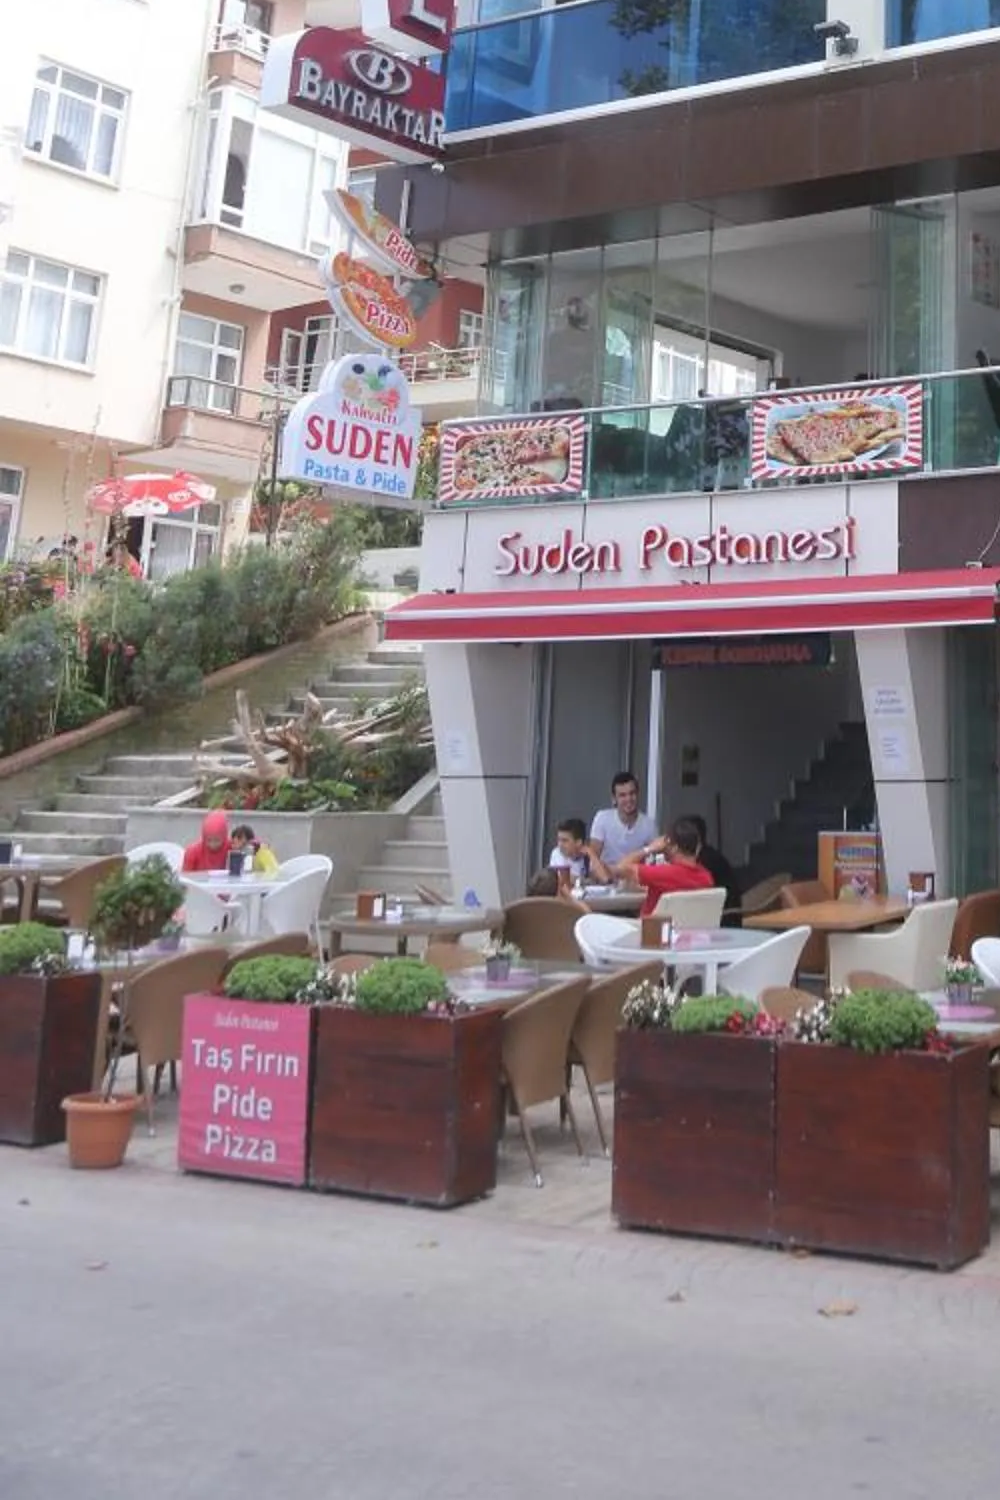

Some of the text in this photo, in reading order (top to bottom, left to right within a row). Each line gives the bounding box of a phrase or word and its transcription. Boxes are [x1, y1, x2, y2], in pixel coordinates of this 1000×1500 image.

[295, 57, 446, 150] BAYRAKTAR
[305, 414, 413, 469] SUDEN
[304, 458, 407, 495] Pasta & Pide
[495, 515, 857, 577] Suden Pastanesi
[191, 1038, 299, 1077] Taş Fırın
[213, 1083, 273, 1121] Pide
[205, 1123, 277, 1164] Pizza
